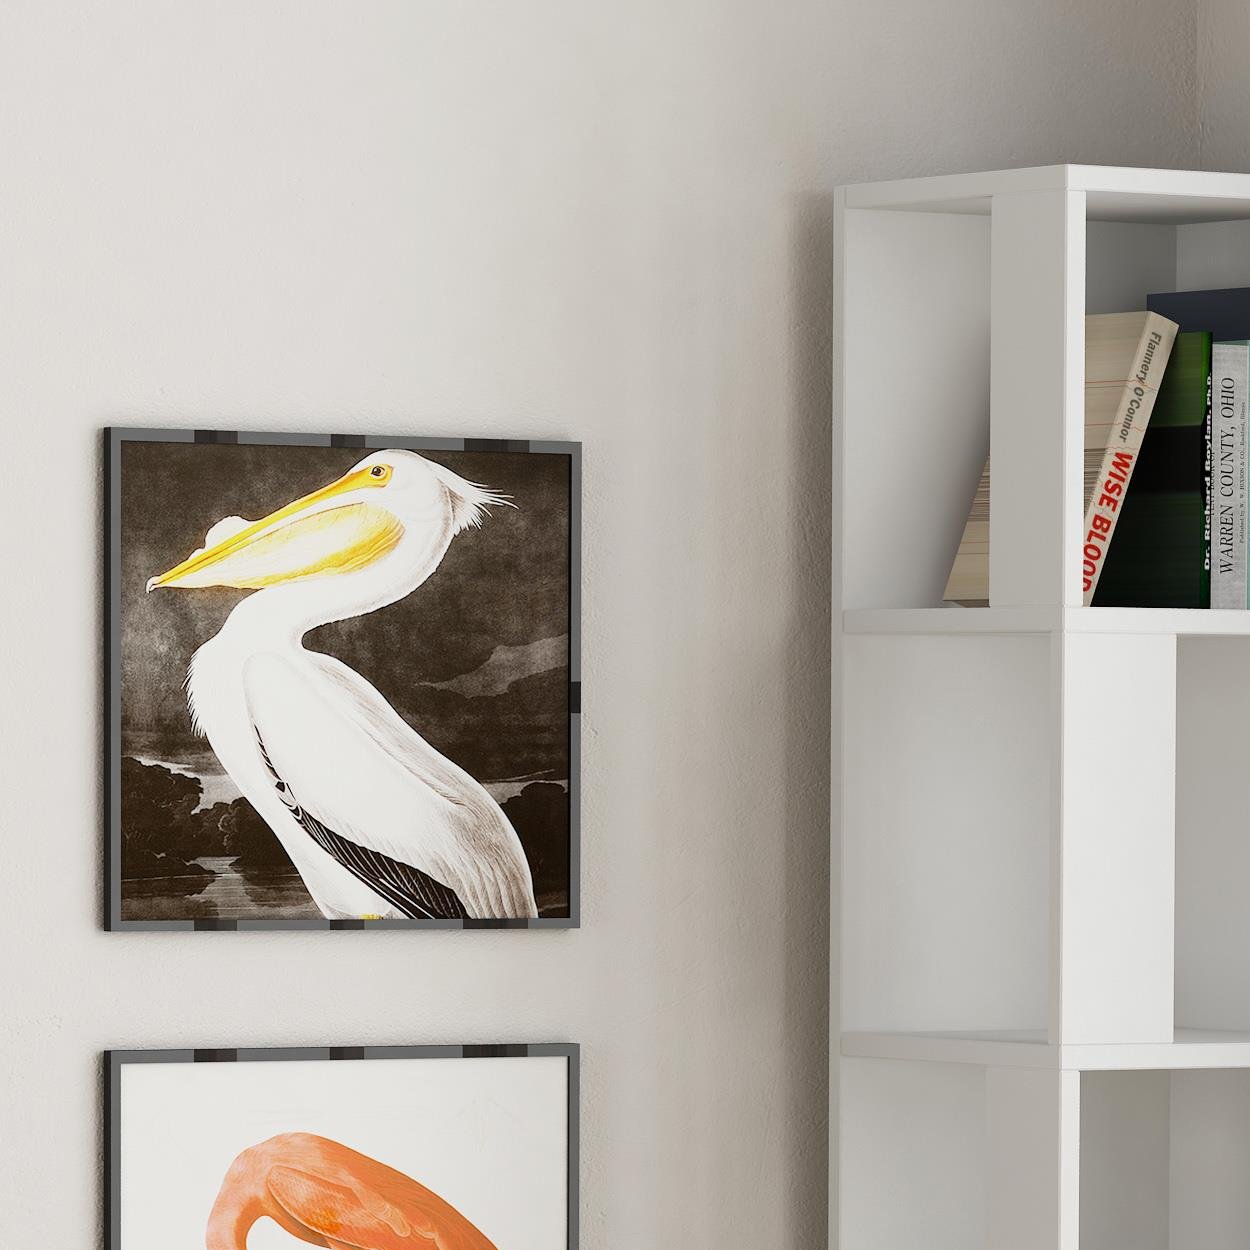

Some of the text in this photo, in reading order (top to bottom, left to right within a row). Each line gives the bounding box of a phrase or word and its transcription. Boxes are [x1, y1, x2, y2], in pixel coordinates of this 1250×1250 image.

[1119, 331, 1161, 443] Flannery O'Connor
[1098, 452, 1133, 513] WISE
[1219, 377, 1236, 574] WARREN COUNTY, OHIO
